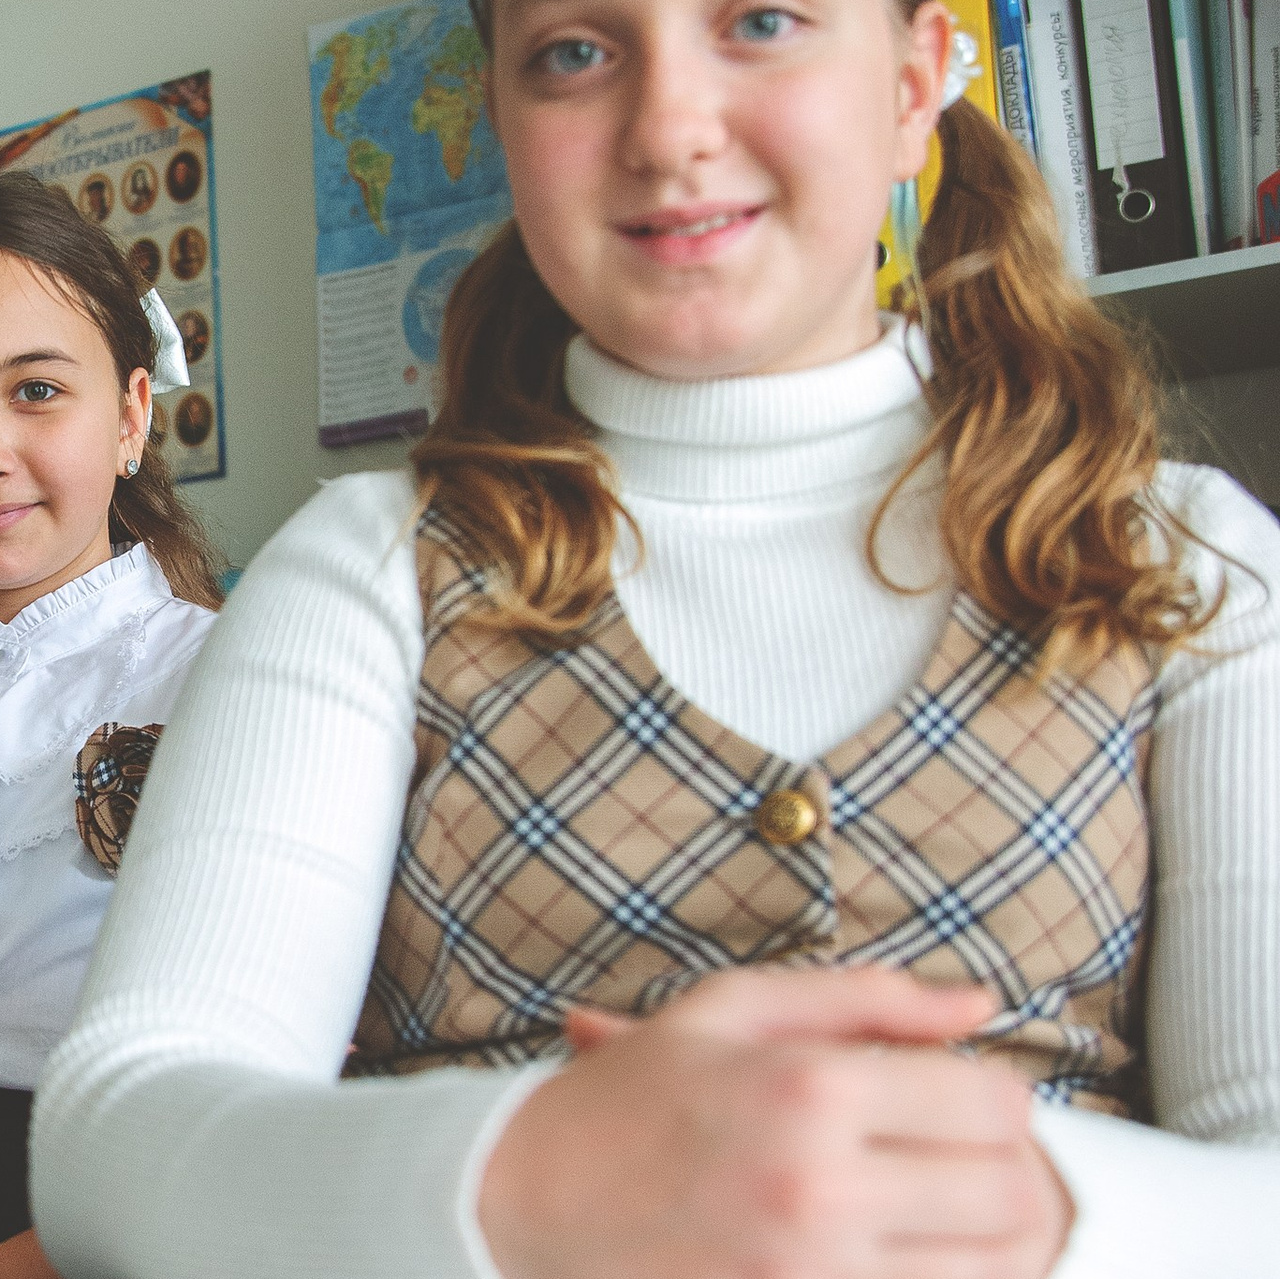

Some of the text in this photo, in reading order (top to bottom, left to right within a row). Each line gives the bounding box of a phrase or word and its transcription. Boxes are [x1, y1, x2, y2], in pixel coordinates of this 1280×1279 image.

[1049, 11, 1069, 81] конкурсы
[1002, 48, 1025, 131] ДОКЛАДЫ
[1074, 189, 1097, 278] неклассные
